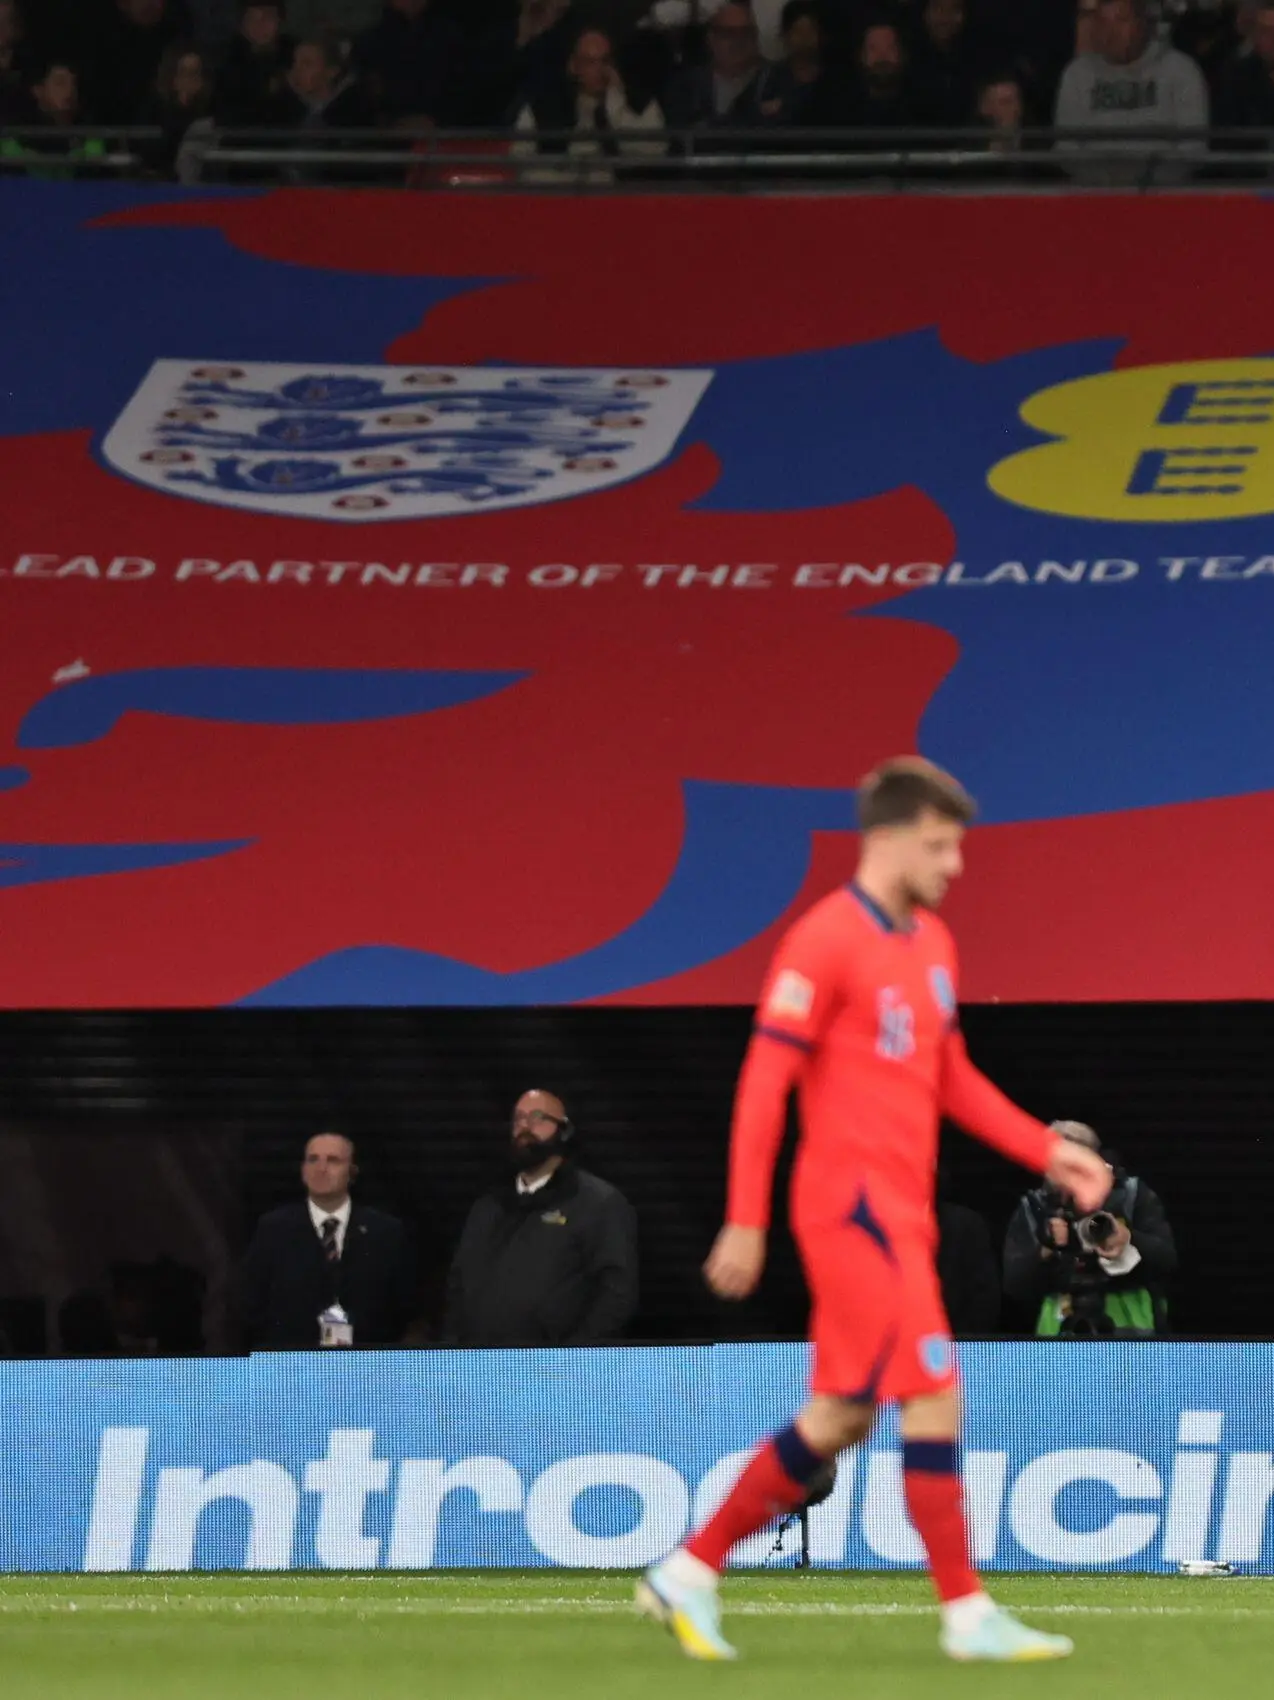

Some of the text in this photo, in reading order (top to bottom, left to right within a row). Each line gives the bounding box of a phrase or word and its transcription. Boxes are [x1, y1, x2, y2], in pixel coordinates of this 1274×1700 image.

[0, 554, 156, 580] EAD
[175, 558, 509, 586] PARTNER
[527, 563, 622, 588] OF
[637, 564, 777, 588] THE
[791, 559, 1140, 588] ENGLAND
